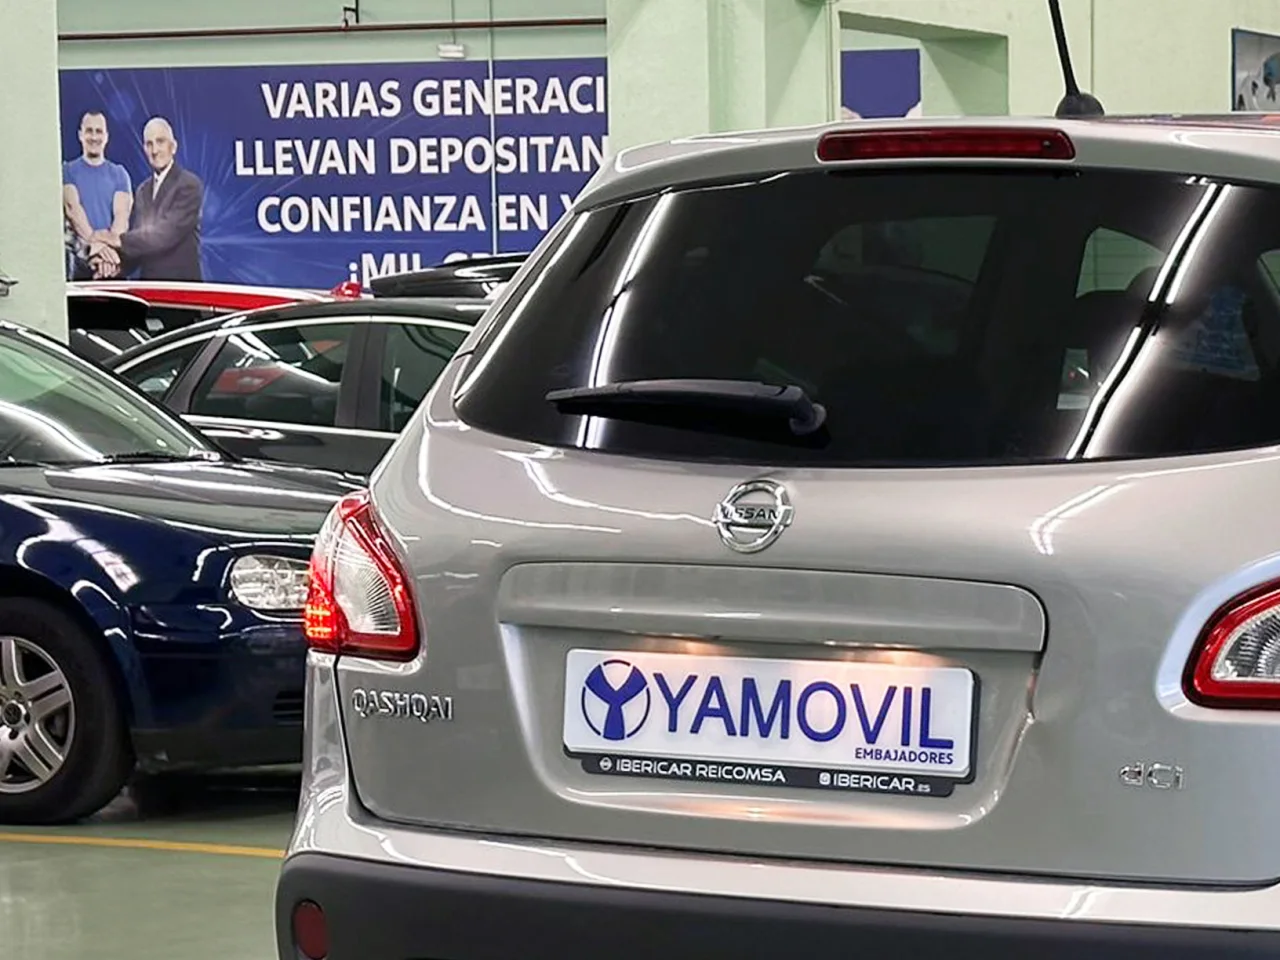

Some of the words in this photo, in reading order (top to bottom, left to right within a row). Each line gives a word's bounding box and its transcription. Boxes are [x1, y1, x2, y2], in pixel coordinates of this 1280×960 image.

[261, 80, 402, 119] VARIAS
[411, 75, 605, 116] GENERACI
[234, 139, 376, 176] LLEVAN
[389, 134, 609, 174] DEPOSITAN
[257, 194, 486, 232] CONFIANZA
[499, 194, 548, 231] EN
[720, 503, 780, 522] NSSAN
[353, 688, 452, 722] QASHQAI
[652, 672, 954, 750] YAMOVIL
[615, 759, 692, 777] IBERICAR
[695, 764, 786, 783] REICOMSA
[855, 747, 954, 766] EMBAJADORES
